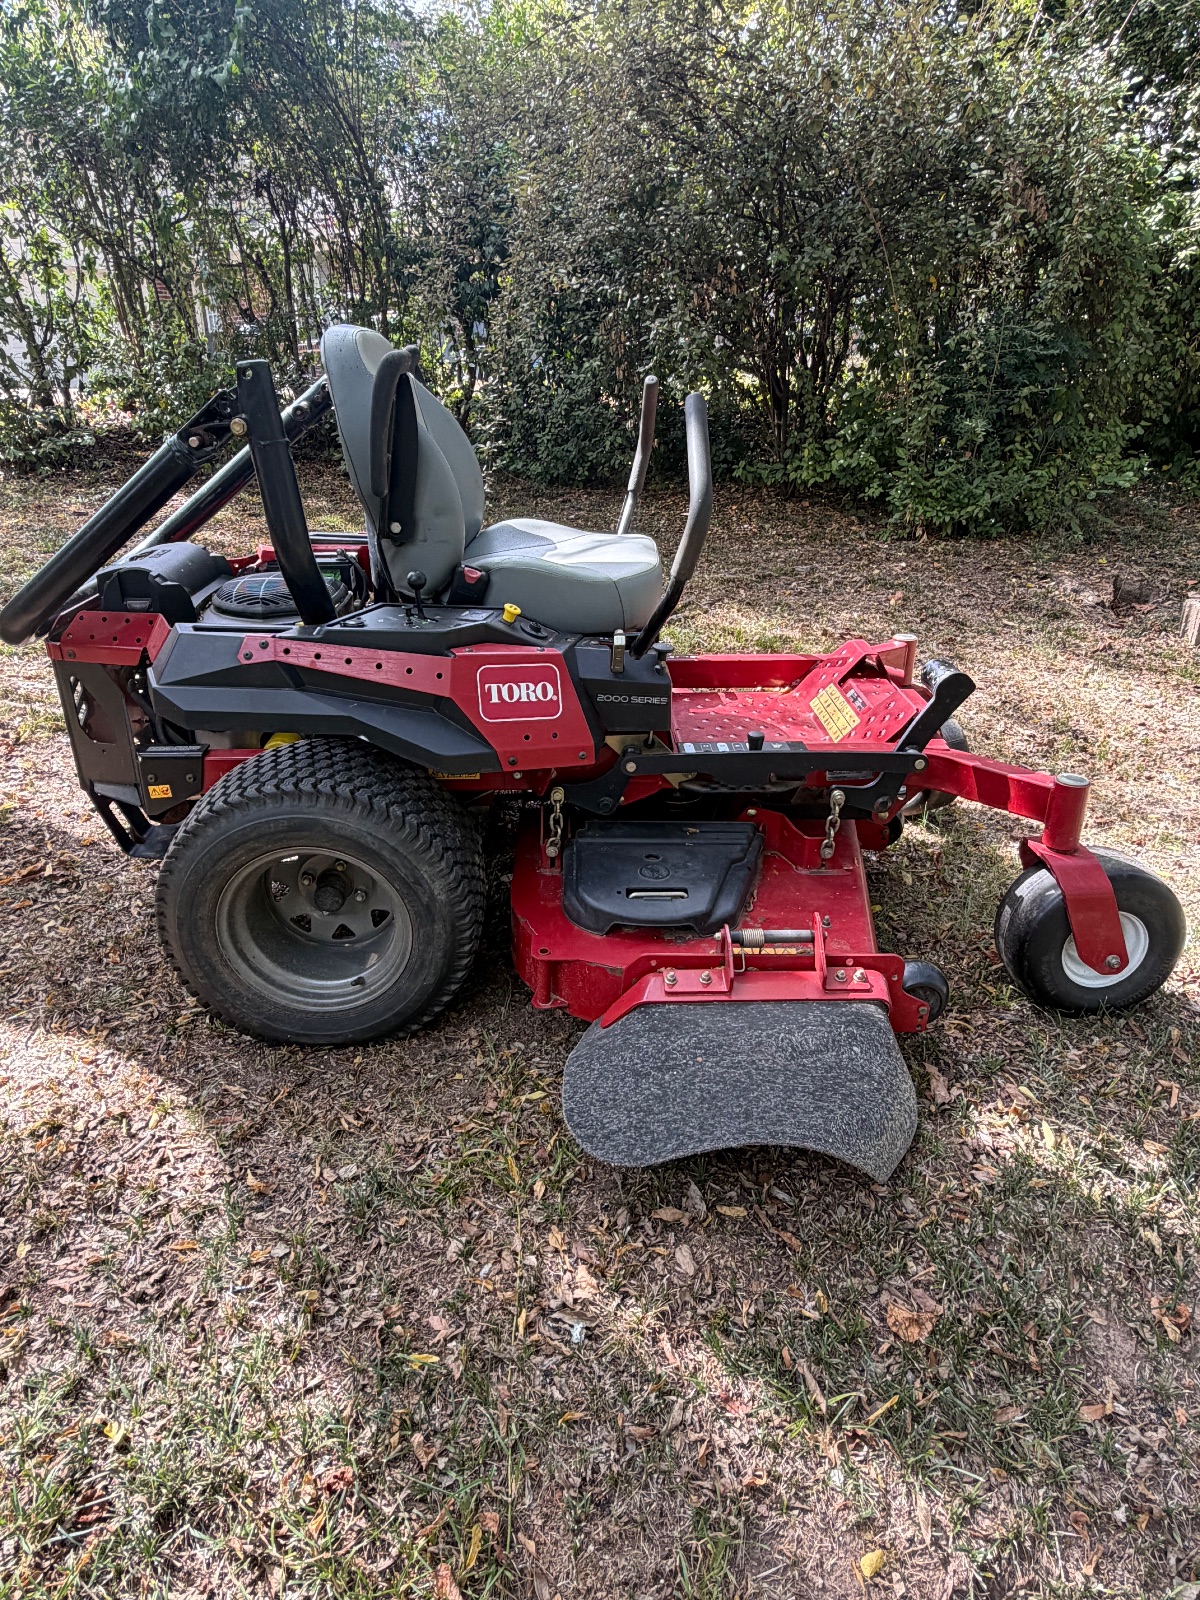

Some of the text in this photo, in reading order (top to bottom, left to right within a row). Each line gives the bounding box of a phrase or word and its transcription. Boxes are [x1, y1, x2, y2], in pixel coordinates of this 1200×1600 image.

[485, 682, 554, 704] TORO
[597, 694, 668, 705] 2000 SERIES
